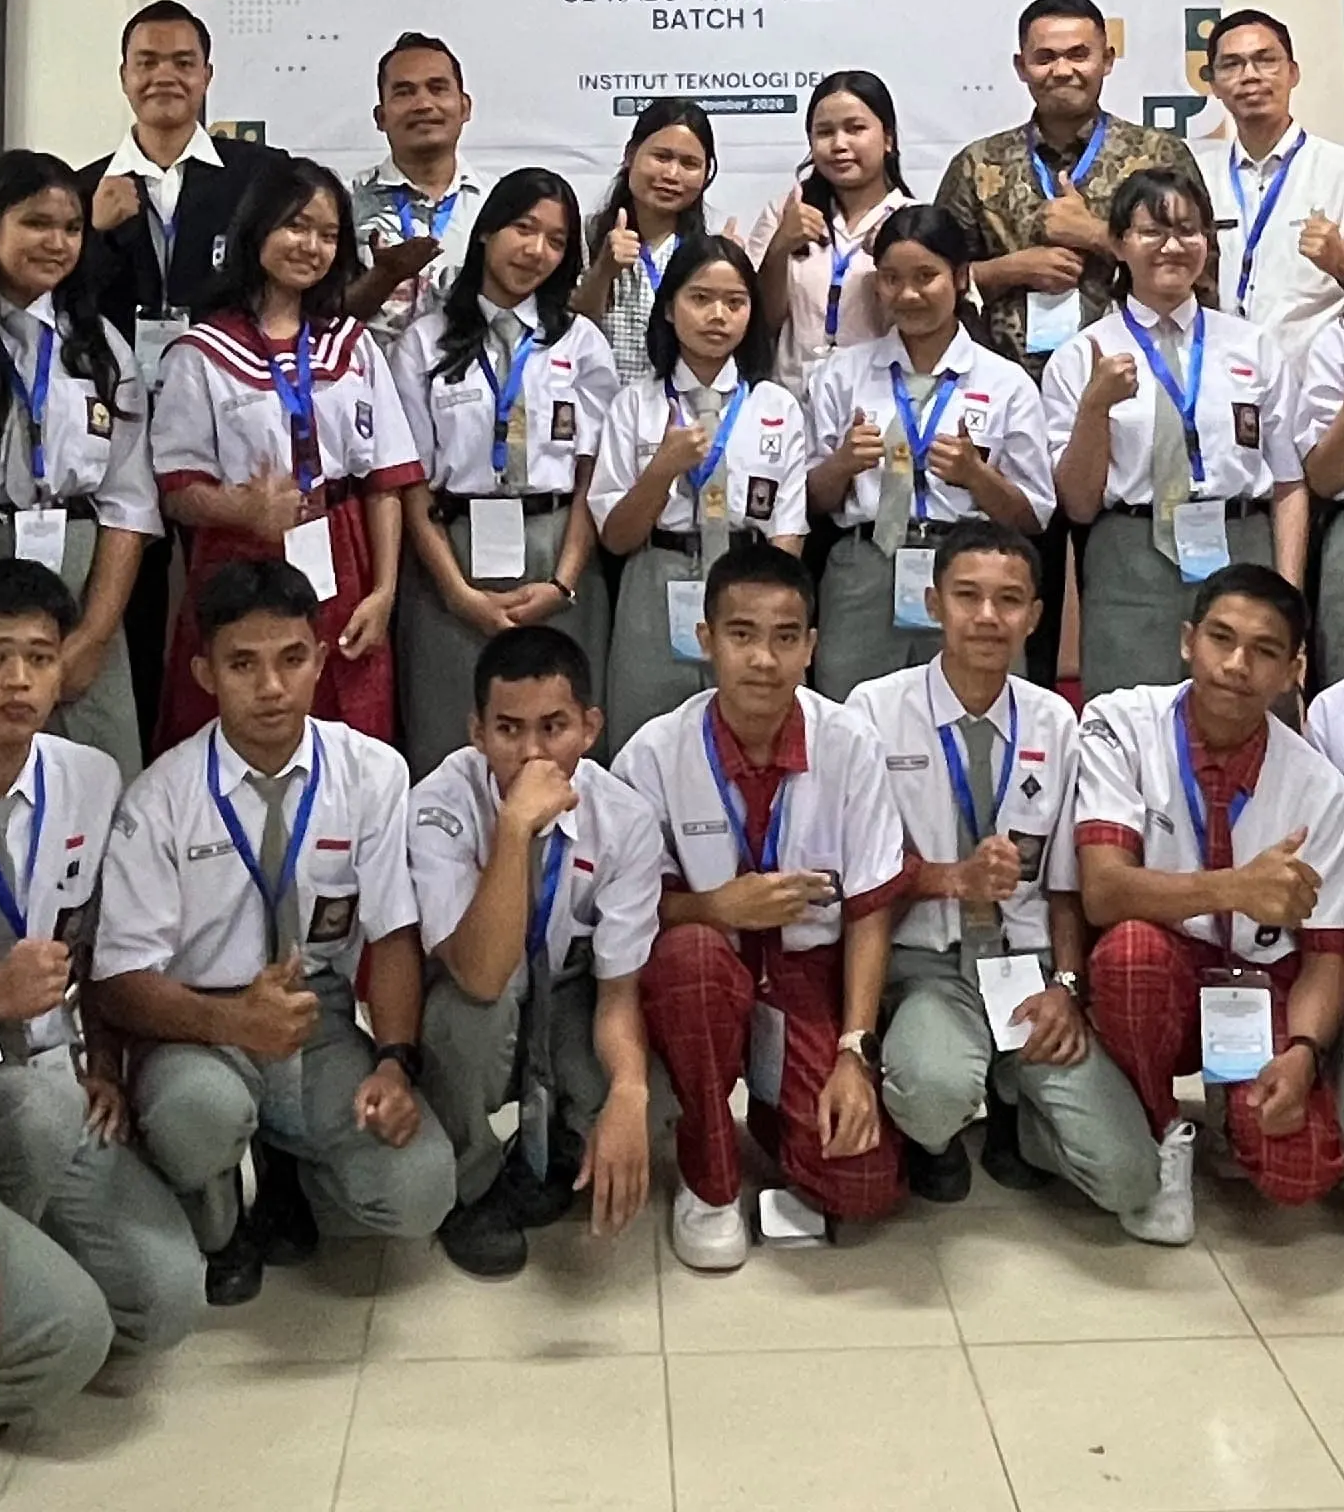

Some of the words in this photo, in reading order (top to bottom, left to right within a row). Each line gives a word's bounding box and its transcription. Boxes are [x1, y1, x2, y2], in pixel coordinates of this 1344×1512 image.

[651, 7, 745, 29] BATCH
[752, 7, 764, 29] 1
[578, 72, 668, 90] INSTITUT
[674, 71, 789, 90] TEKNOLOGI
